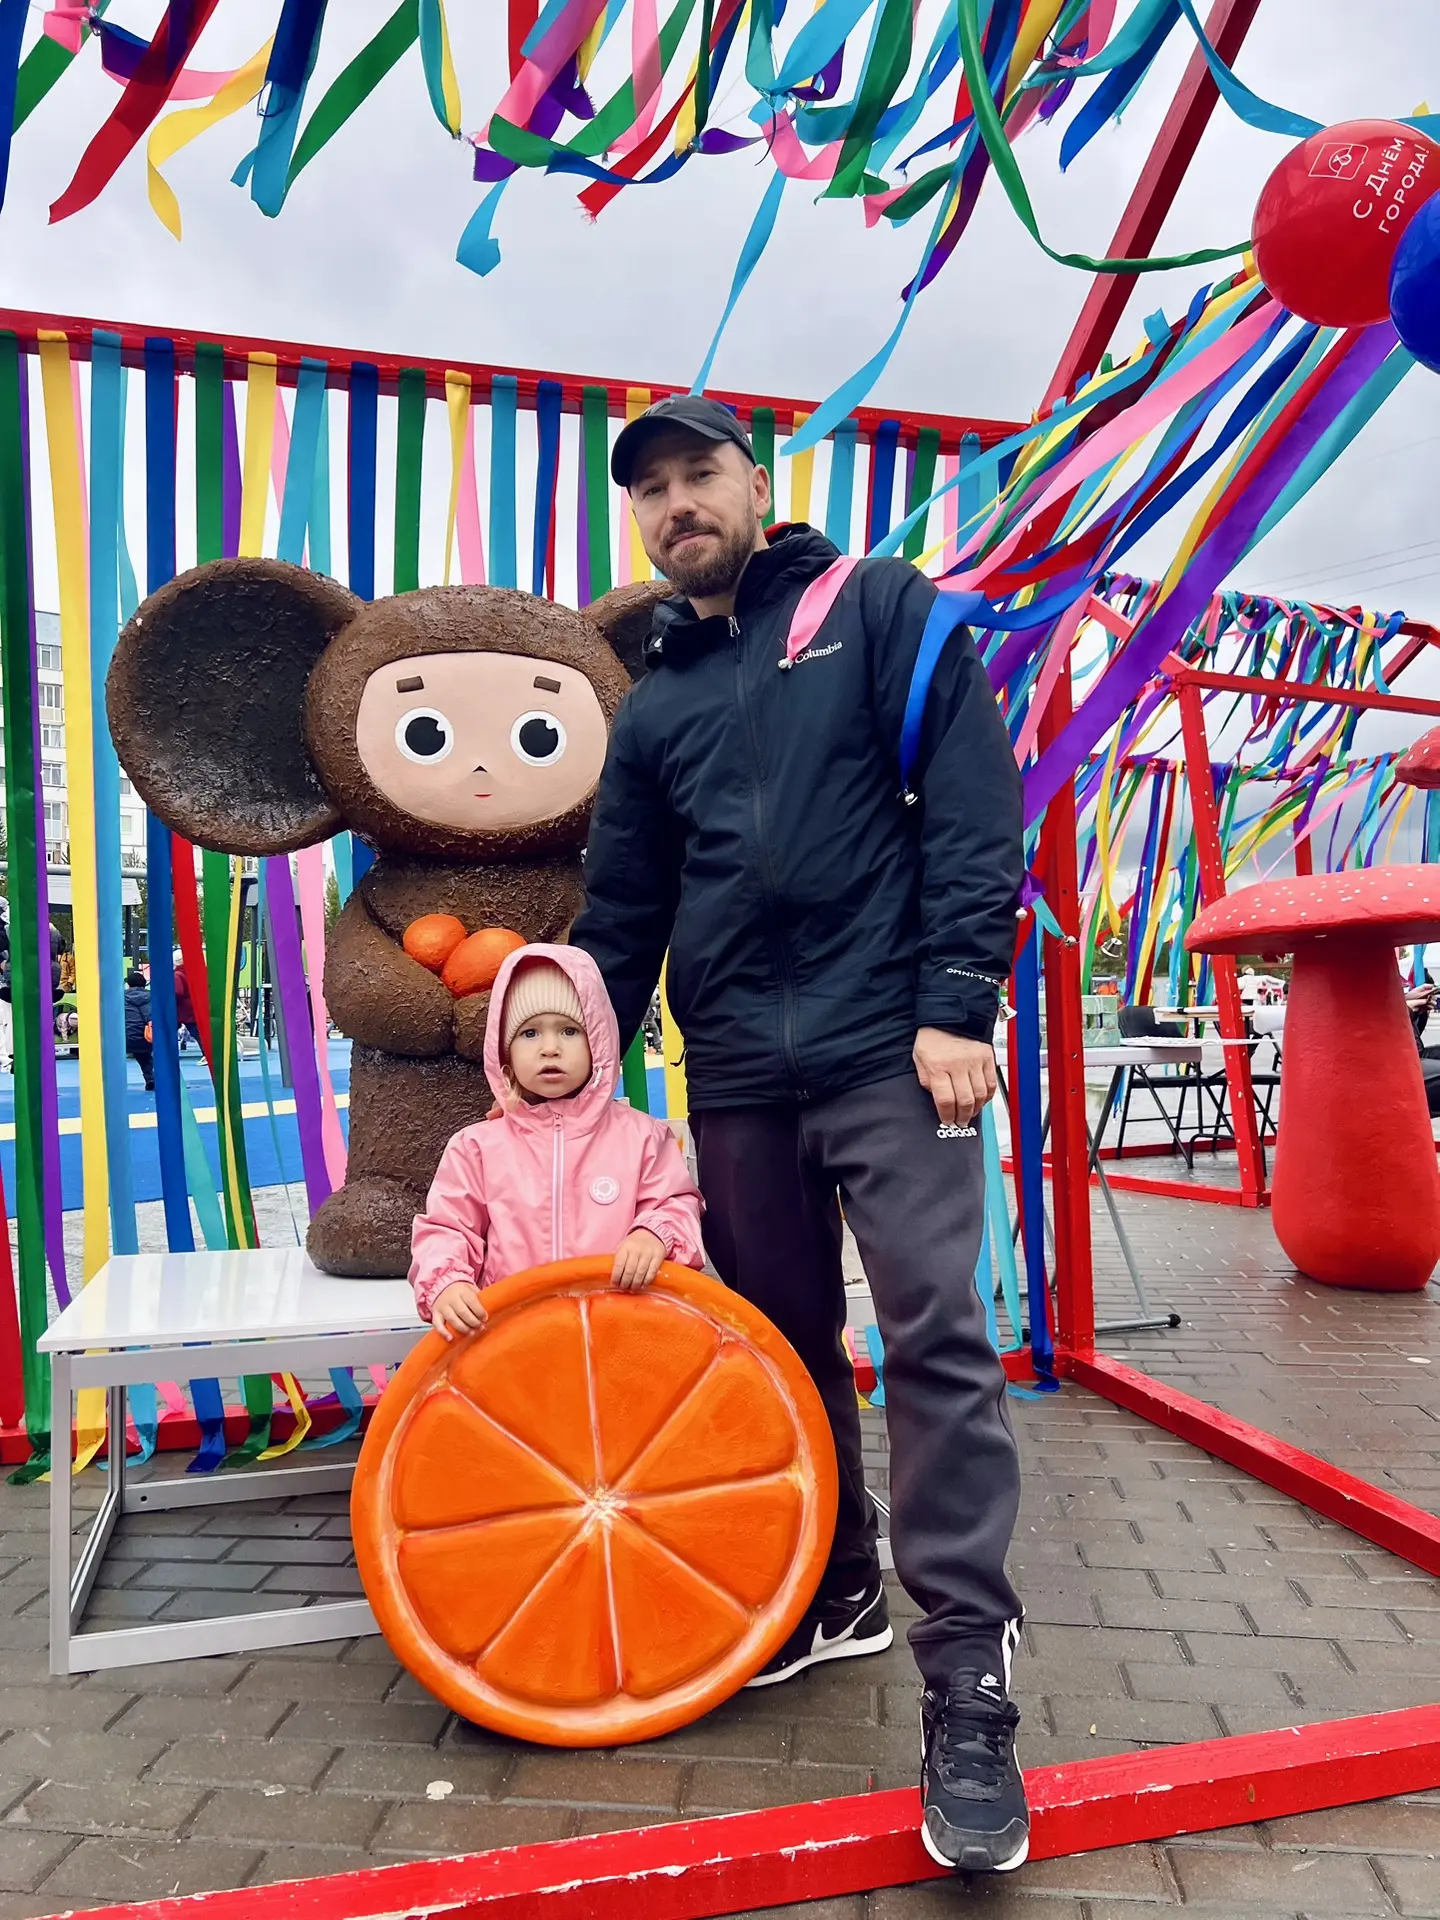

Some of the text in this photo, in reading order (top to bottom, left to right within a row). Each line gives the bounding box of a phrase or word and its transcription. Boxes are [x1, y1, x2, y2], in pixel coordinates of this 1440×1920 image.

[1353, 137, 1406, 219] С ДНЁМ
[1378, 143, 1430, 234] ГОРОДА!
[795, 641, 843, 664] Columbia
[936, 1127, 978, 1139] adidas
